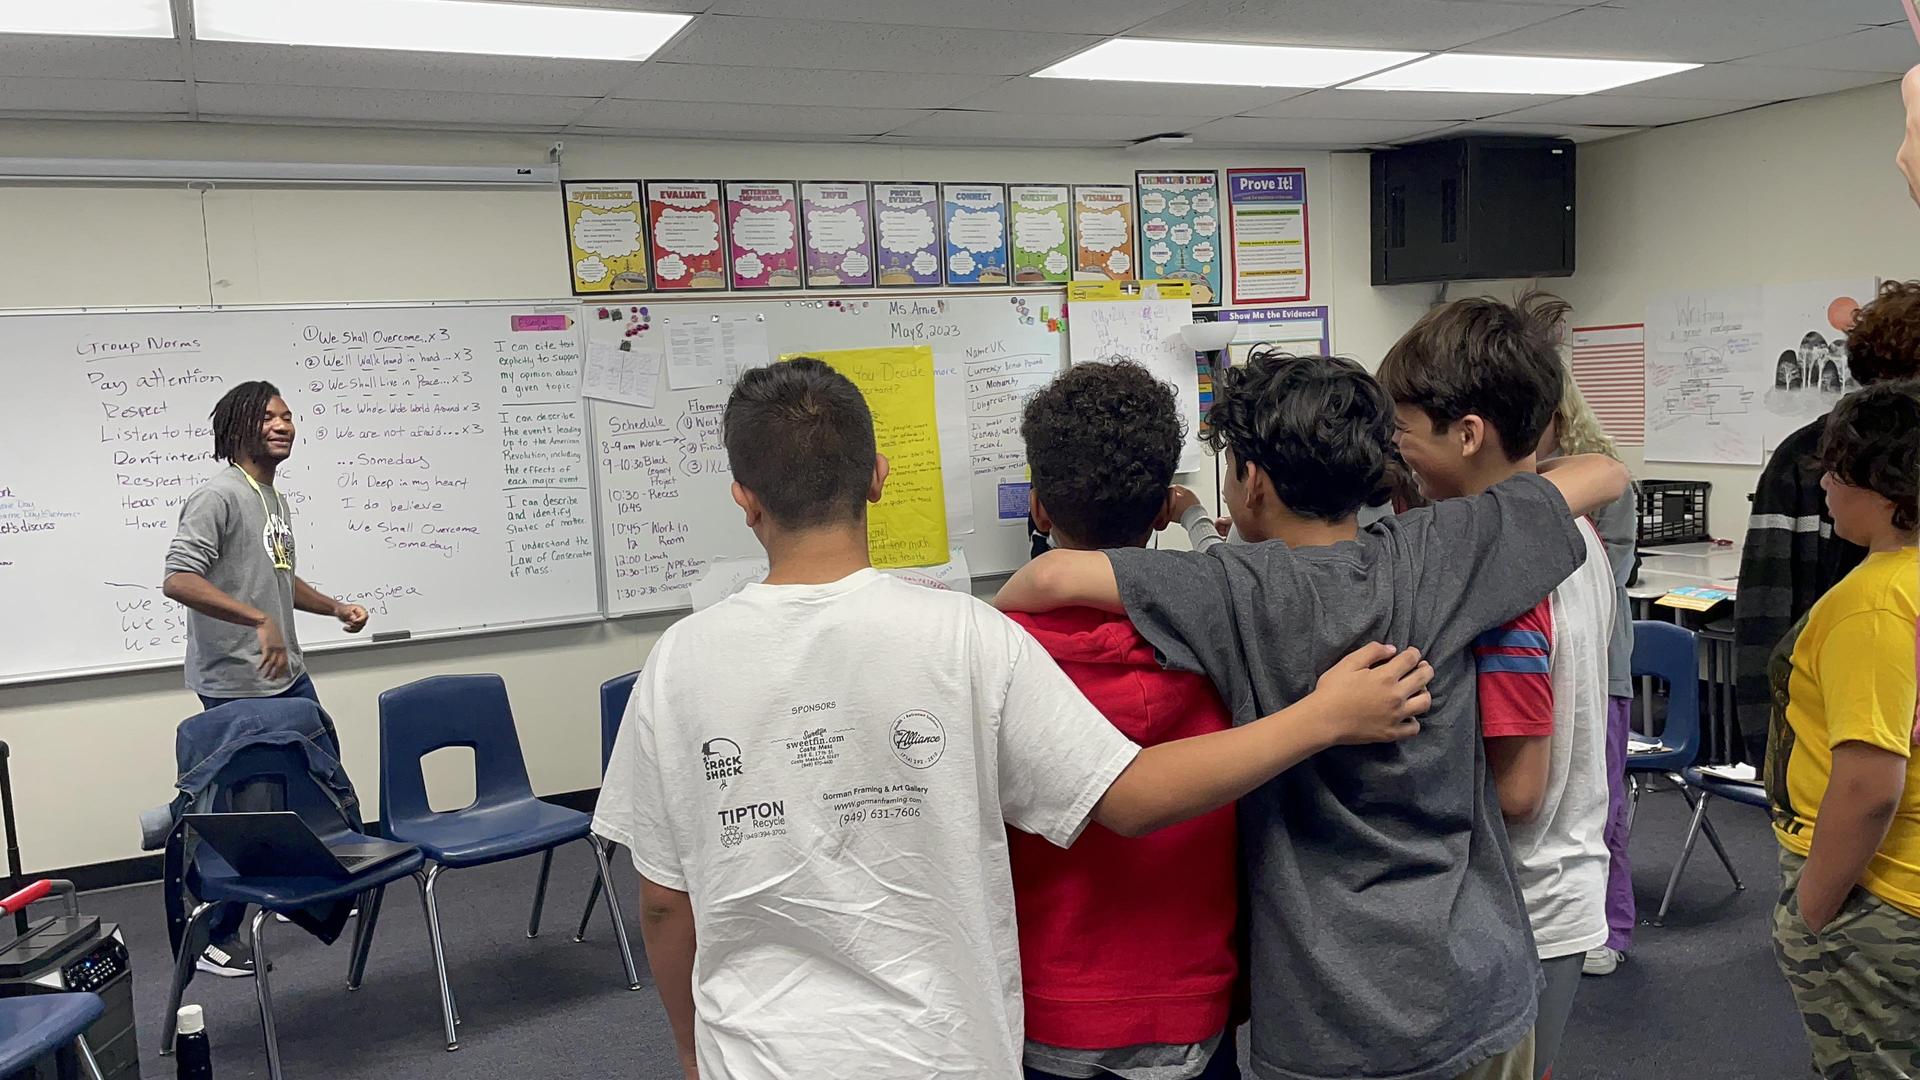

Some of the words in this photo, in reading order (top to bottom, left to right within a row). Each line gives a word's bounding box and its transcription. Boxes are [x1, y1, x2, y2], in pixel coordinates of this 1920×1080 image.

[1141, 176, 1183, 185] THINKING
[1186, 176, 1212, 184] STEMS
[1240, 177, 1275, 190] Prove
[1277, 177, 1293, 189] It!
[660, 191, 707, 199] EVALUATE
[889, 196, 922, 204] EVIDENCE
[956, 193, 992, 201] CONNECT
[1230, 311, 1250, 320] Show
[1282, 310, 1317, 318] Evidence!
[319, 331, 339, 344] We
[342, 331, 368, 343] Shall
[77, 341, 140, 355] Group
[147, 337, 201, 350] Norms
[494, 341, 506, 352] I
[535, 341, 557, 350] cite
[323, 354, 351, 367] We'll
[537, 354, 549, 362] to
[501, 371, 514, 383] my
[520, 372, 552, 381] opinion
[880, 362, 926, 380] Decide
[88, 372, 127, 396] Pay
[137, 368, 223, 387] attention
[329, 377, 347, 390] We
[350, 376, 377, 388] Shall
[515, 385, 538, 398] given
[102, 401, 168, 419] Respect
[333, 404, 352, 414] The
[357, 404, 386, 414] Whole
[389, 403, 407, 413] Wide
[410, 403, 430, 413] World
[498, 412, 509, 423] I
[516, 415, 532, 423] can
[537, 411, 575, 421] describe
[609, 416, 665, 433] Schedule
[101, 425, 158, 442] Listen
[162, 425, 179, 438] to
[336, 426, 355, 439] We
[360, 430, 380, 438] are
[384, 426, 406, 437] not
[504, 427, 519, 436] the
[523, 426, 551, 435] events
[518, 438, 527, 446] to
[640, 440, 661, 448] Work
[551, 451, 581, 463] including
[644, 455, 668, 466] Black
[504, 464, 519, 474] the
[117, 473, 181, 487] Respect
[338, 472, 358, 488] Oh
[367, 475, 394, 489] Deep
[412, 479, 430, 491] my
[435, 475, 469, 489] heart
[532, 478, 554, 488] major
[504, 495, 516, 508] I
[543, 493, 578, 506] describe
[648, 489, 679, 500] Recess
[341, 498, 355, 508] I
[364, 499, 379, 510] do
[391, 501, 444, 512] believe
[508, 509, 526, 520] and
[533, 508, 571, 518] identify
[20, 520, 55, 531] discuss
[348, 520, 371, 532] We
[377, 522, 413, 533] Shall
[421, 524, 481, 535] Overcome
[545, 519, 554, 528] of
[652, 521, 674, 533] Work
[506, 540, 515, 553] I
[522, 539, 570, 551] understand
[576, 536, 589, 545] the
[659, 536, 684, 546] Room
[511, 555, 532, 566] Law
[537, 552, 547, 562] of
[645, 552, 668, 562] Lunch
[510, 567, 519, 577] of
[665, 571, 676, 581] for
[792, 701, 836, 714] SPONSORS
[786, 735, 845, 750] sweetfin.com
[897, 730, 940, 749] Alliance
[704, 755, 742, 770] CRACK
[706, 766, 743, 781] SHACK
[823, 790, 852, 800] Gorman
[854, 786, 883, 795] Framing
[905, 785, 928, 794] Gallery
[718, 800, 784, 825] TIPTON
[839, 809, 866, 828] (949)
[870, 808, 920, 818] 631-7606
[753, 816, 785, 828] Recycle
